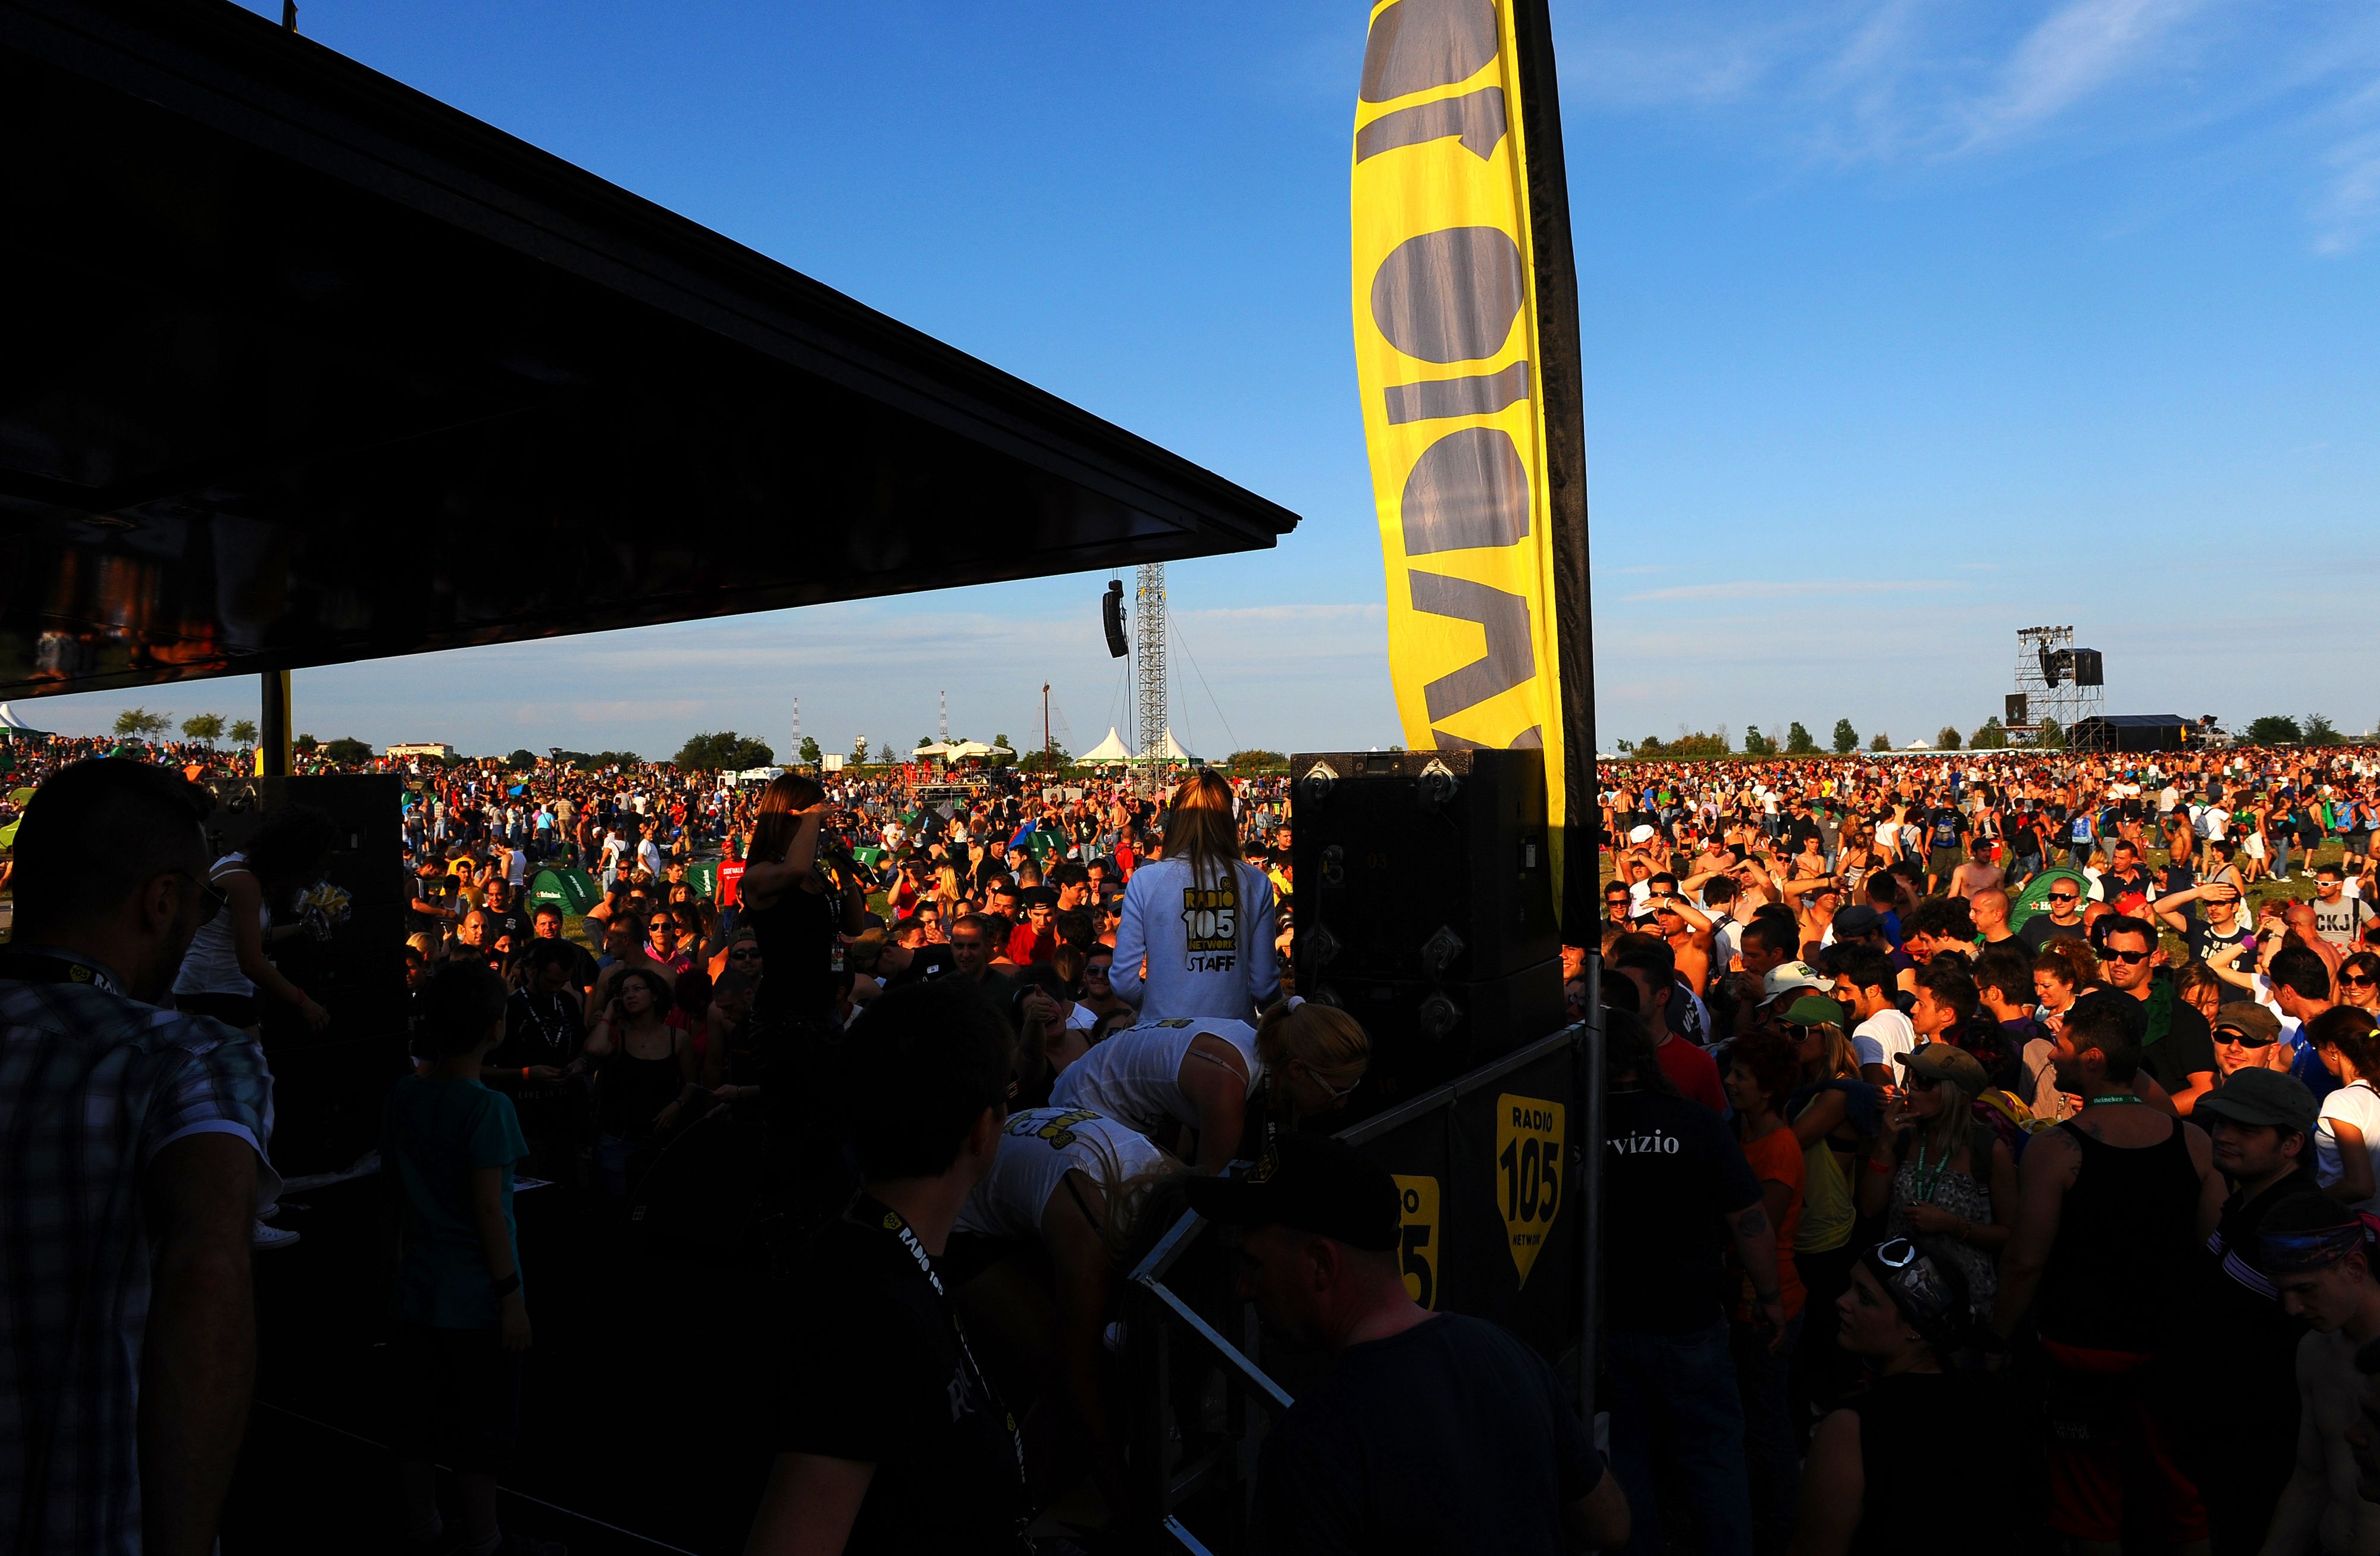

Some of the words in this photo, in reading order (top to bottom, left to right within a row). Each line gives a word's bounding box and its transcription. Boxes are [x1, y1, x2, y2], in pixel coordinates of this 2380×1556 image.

[1185, 891, 1234, 908] RADIO
[1183, 909, 1235, 940] 105
[1189, 940, 1234, 950] NETWORK
[1187, 956, 1236, 972] STAFF
[1512, 1106, 1552, 1133] RADIO
[1500, 1137, 1559, 1223] 105
[886, 1214, 899, 1228] 105
[1512, 1233, 1541, 1247] NETWORK
[898, 1227, 931, 1272] RADIO
